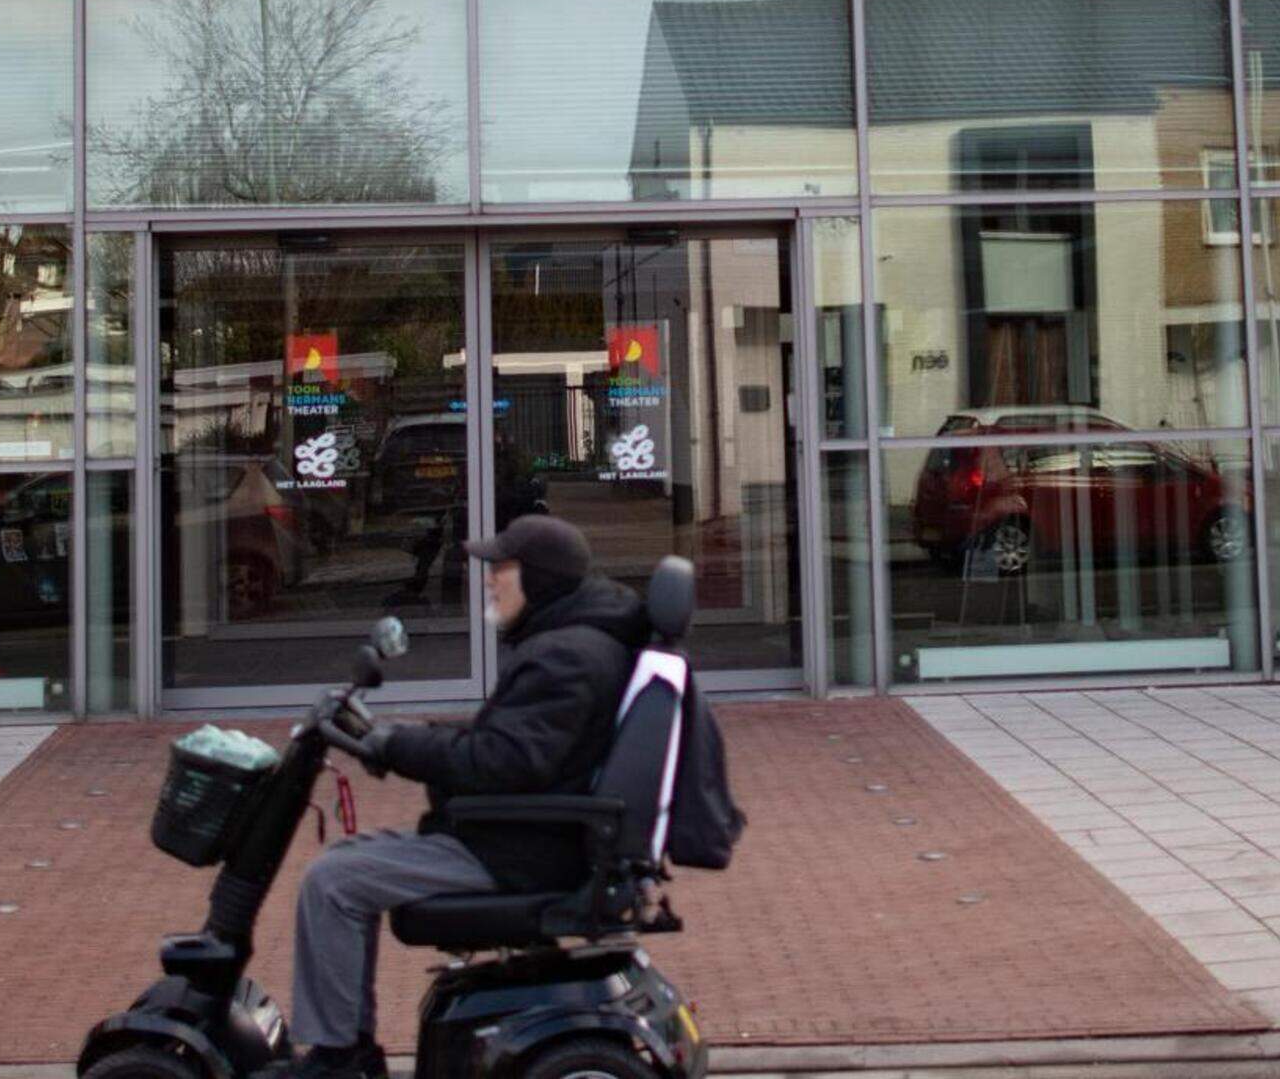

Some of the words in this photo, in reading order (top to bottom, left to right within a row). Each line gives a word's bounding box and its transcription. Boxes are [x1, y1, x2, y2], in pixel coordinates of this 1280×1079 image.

[287, 385, 321, 395] TOON
[287, 394, 346, 405] HERMANS
[609, 397, 660, 408] THEATER
[287, 405, 339, 415] THEATER
[276, 481, 295, 489] HET
[297, 479, 347, 489] LAAGLAND
